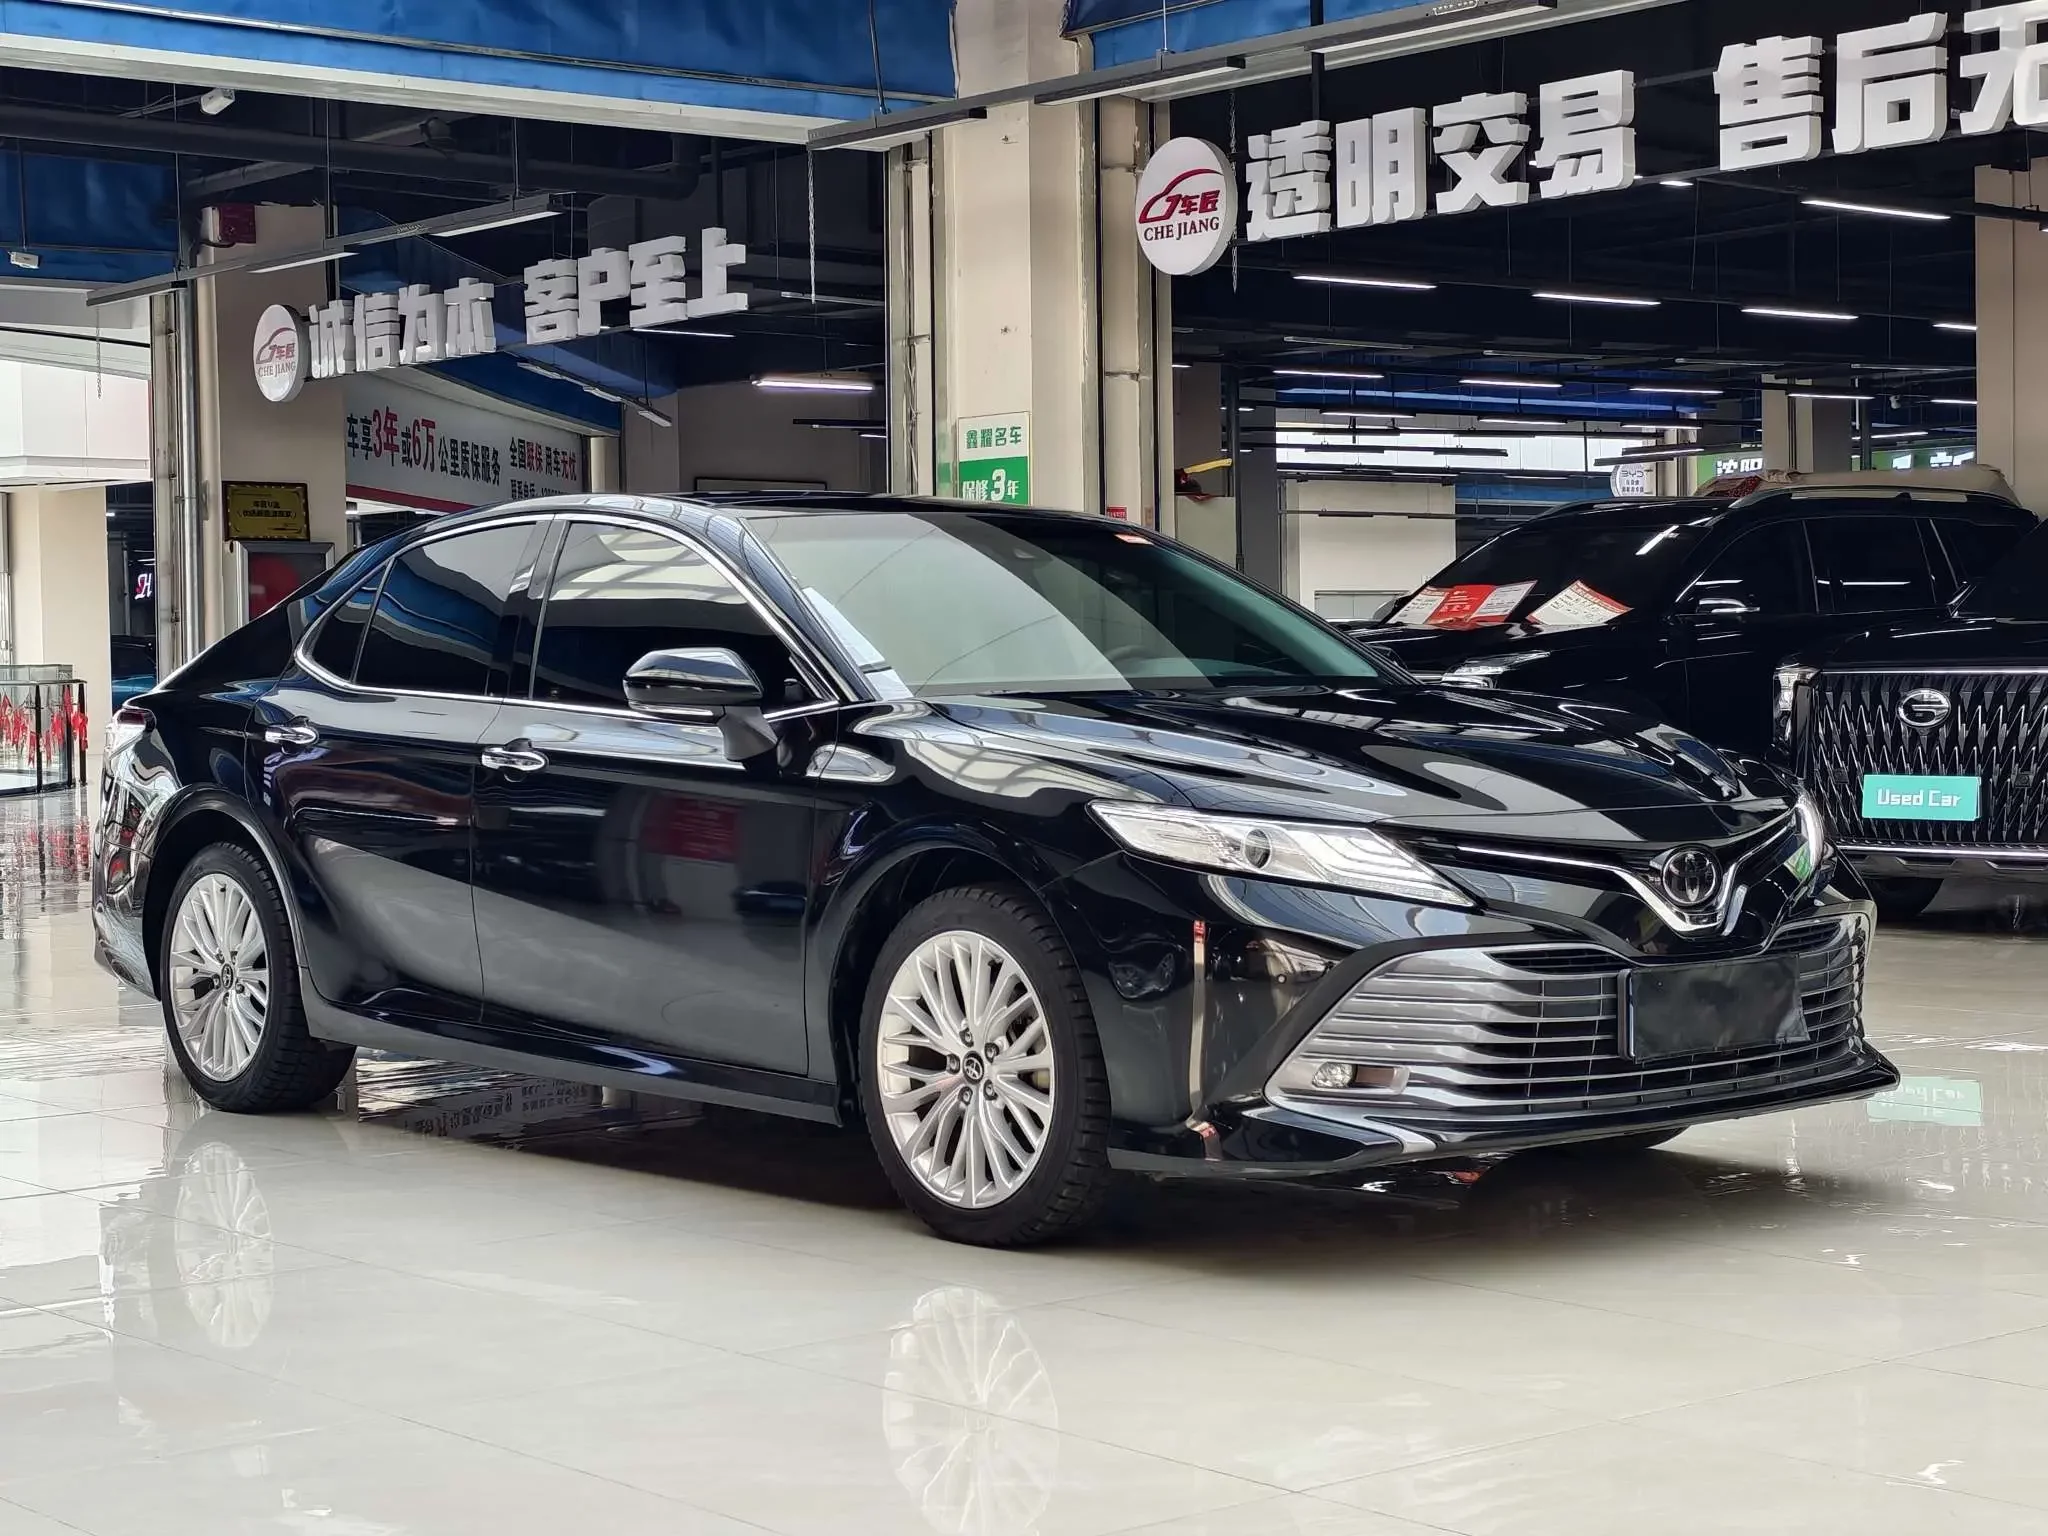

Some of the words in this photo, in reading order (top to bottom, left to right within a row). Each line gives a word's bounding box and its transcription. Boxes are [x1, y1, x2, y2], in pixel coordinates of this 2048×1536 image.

[1246, 70, 1637, 242] 透明交易
[1144, 224, 1174, 241] CHE
[1176, 216, 1220, 240] JIANG
[308, 277, 496, 379] 诚信为本
[523, 226, 748, 345] 客户至上
[258, 364, 274, 378] CHE
[275, 361, 297, 378] JIANG
[962, 468, 1020, 501] 保修3年
[1877, 788, 1923, 806] Used
[1928, 789, 1962, 807] Car
